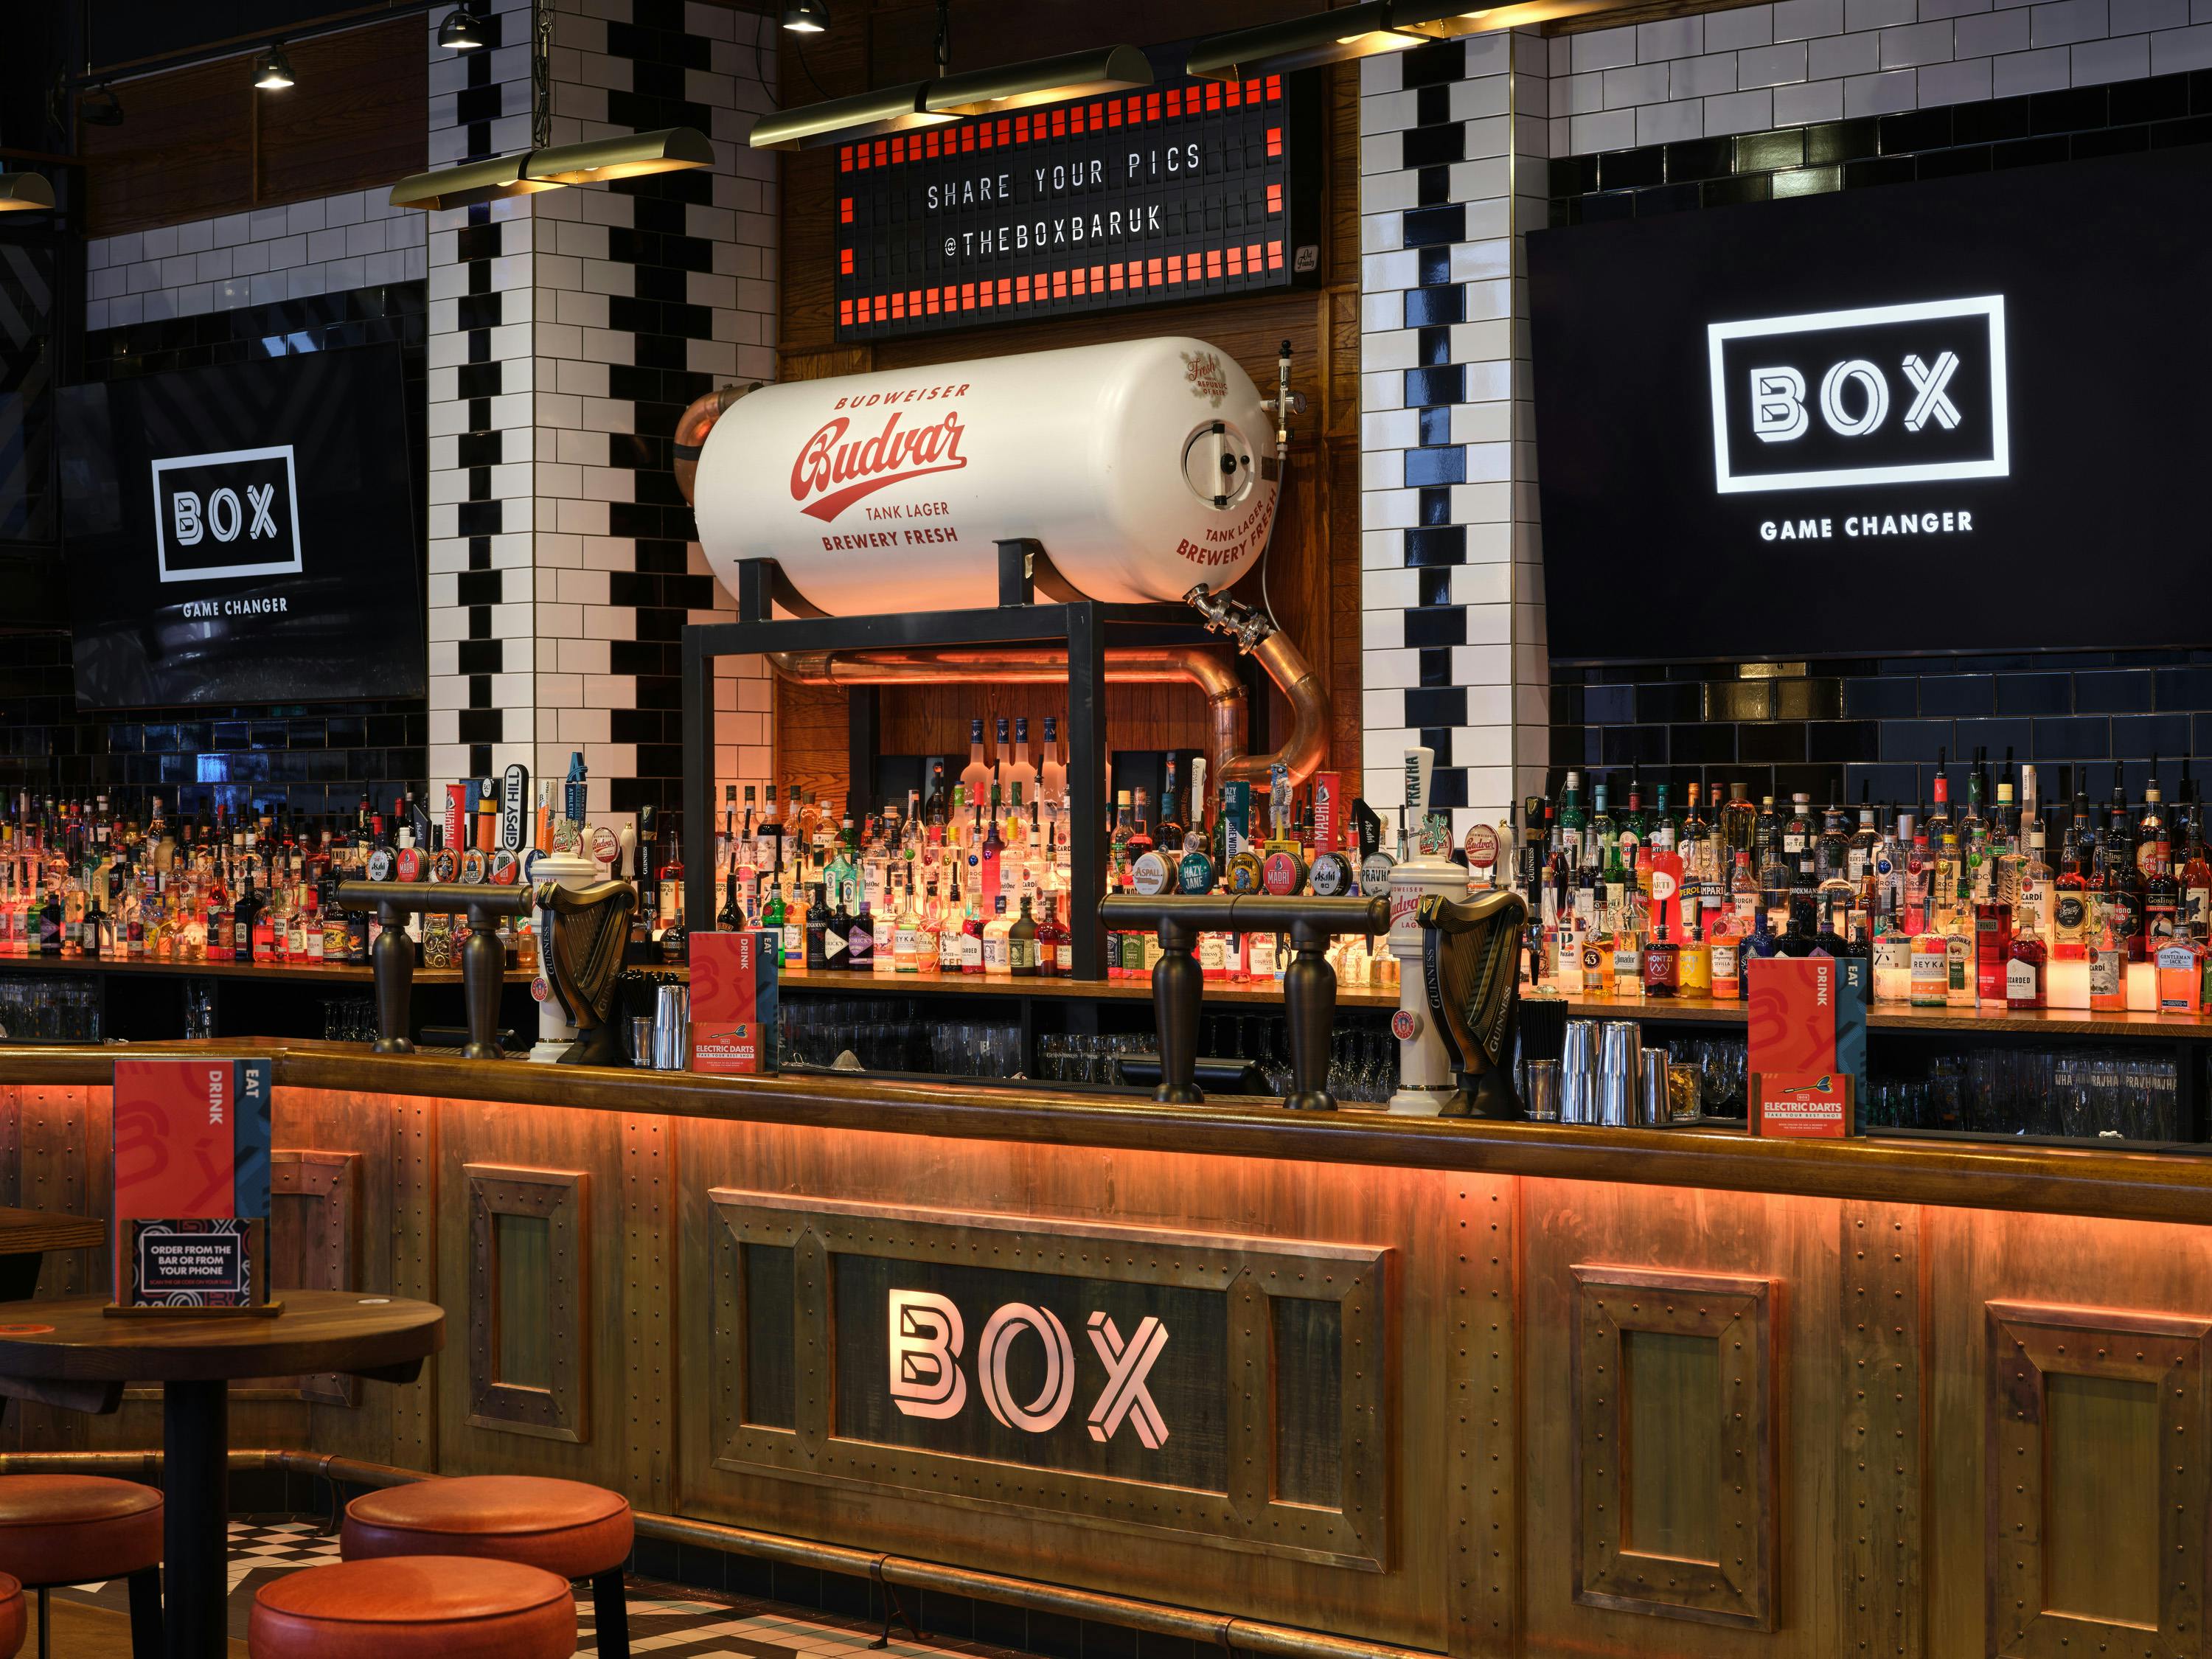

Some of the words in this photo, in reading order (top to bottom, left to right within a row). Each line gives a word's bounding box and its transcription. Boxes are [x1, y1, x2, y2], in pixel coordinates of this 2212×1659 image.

[928, 174, 1009, 209] SHARE
[1035, 159, 1102, 192] YOUR
[1129, 143, 1199, 178] PICS
[945, 204, 1161, 257] @THEBOXBARUK
[1187, 353, 1216, 381] Fresh
[1197, 380, 1228, 389] REPUBLIC
[833, 383, 970, 410] BUDWEISER
[1750, 351, 1962, 442] BOX
[790, 411, 967, 501] Budvar
[173, 483, 278, 546] BOX
[865, 505, 902, 521] TANK
[905, 501, 950, 518] LAGER
[1205, 527, 1236, 543] TANK
[1237, 499, 1264, 536] LAGER
[1175, 538, 1248, 566] BREWERY
[1250, 487, 1277, 546] FRESH
[1760, 518, 1832, 540] GAME
[1844, 511, 1973, 536] CHANGER
[821, 531, 898, 552] BREWERY
[903, 526, 959, 545] FRESH
[183, 602, 219, 618] GAME
[224, 597, 288, 615] CHANGER
[507, 771, 520, 802] HILL
[1405, 755, 1422, 807] PRAVHA
[505, 805, 519, 848] GIPSY
[1364, 820, 1376, 844] Asahi
[593, 838, 615, 849] Budvar
[1466, 837, 1495, 850] Budvar
[371, 860, 386, 872] Asahi
[497, 855, 510, 871] JUBEL
[1135, 867, 1160, 877] ASPALL
[1183, 865, 1202, 879] HAZY
[1231, 860, 1253, 870] WINGMAN
[1186, 876, 1204, 889] JANE
[1314, 870, 1335, 882] Asahi
[1390, 894, 1422, 916] udva
[2021, 891, 2042, 901] CARDÍ
[2148, 896, 2176, 905] Goslings
[1978, 921, 1997, 931] THUNDER
[543, 925, 554, 975] GUINNESS
[740, 938, 749, 970] DRINK
[764, 937, 772, 955] EAT
[1585, 953, 1596, 964] 43
[1615, 954, 1635, 965] Jimador
[598, 957, 621, 1012] GUINNESS
[1426, 948, 1440, 1009] GUINNESS
[1817, 966, 1828, 1006] DRINK
[1848, 965, 1858, 987] EAT
[1489, 984, 1512, 1053] GUINNESS
[696, 1045, 730, 1053] ELECTRIC
[245, 1068, 260, 1099] EAT
[209, 1070, 223, 1125] DRINK
[1764, 1102, 1808, 1111] ELECTRIC
[1809, 1102, 1842, 1112] DARTS
[150, 1245, 184, 1254] ORDER
[184, 1245, 213, 1254] FROM
[214, 1245, 232, 1254] THE
[158, 1256, 178, 1265] BAR
[179, 1256, 194, 1265] OR
[195, 1256, 224, 1265] FROM
[159, 1266, 187, 1276] YOUR
[188, 1266, 223, 1276] PHONE
[888, 1288, 1170, 1450] BOX
